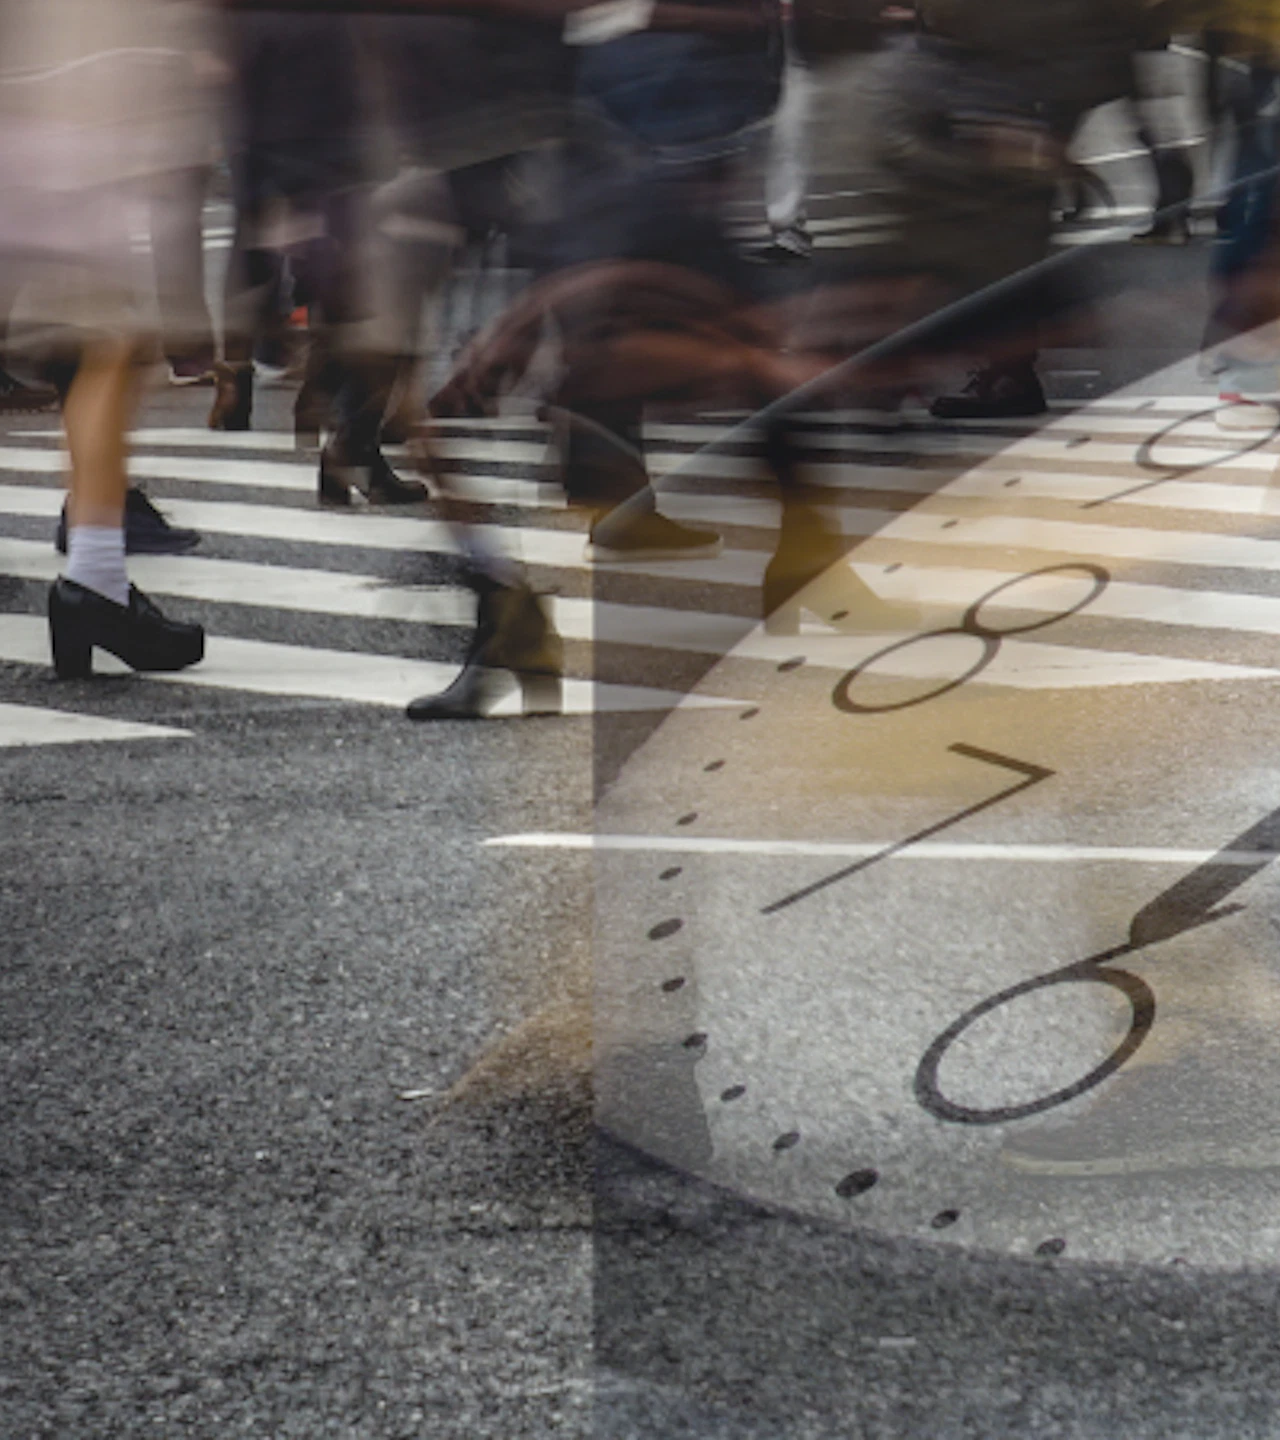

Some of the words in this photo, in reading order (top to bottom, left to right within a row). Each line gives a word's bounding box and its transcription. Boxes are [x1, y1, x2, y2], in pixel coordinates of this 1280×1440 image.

[831, 561, 1111, 715] 8
[759, 740, 1057, 914] 7
[914, 903, 1246, 1126] 6
